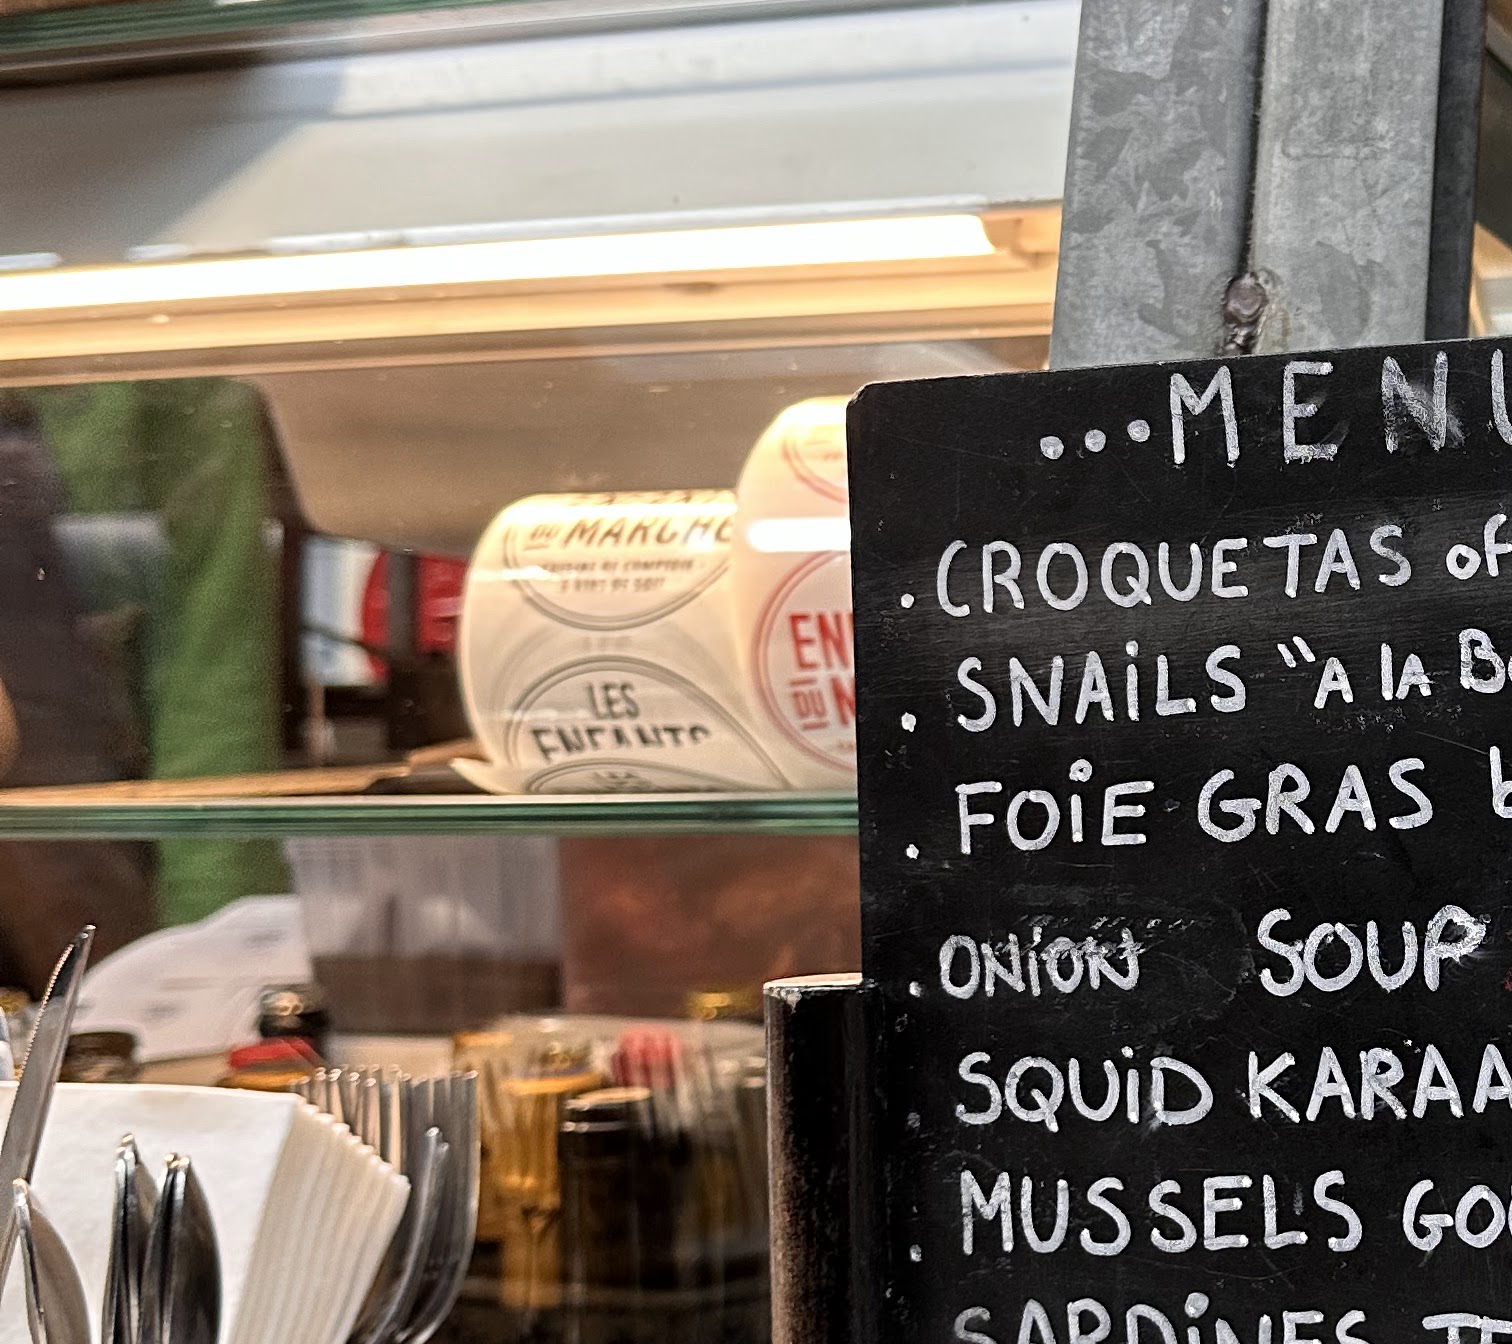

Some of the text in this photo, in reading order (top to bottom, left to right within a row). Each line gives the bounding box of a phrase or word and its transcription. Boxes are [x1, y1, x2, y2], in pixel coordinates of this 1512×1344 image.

[936, 525, 1414, 617] CROQUETAS
[586, 680, 641, 723] LES
[1197, 757, 1434, 843] GRAS
[1256, 904, 1490, 997] SOUP
[959, 1169, 1363, 1257] MUSSELS
